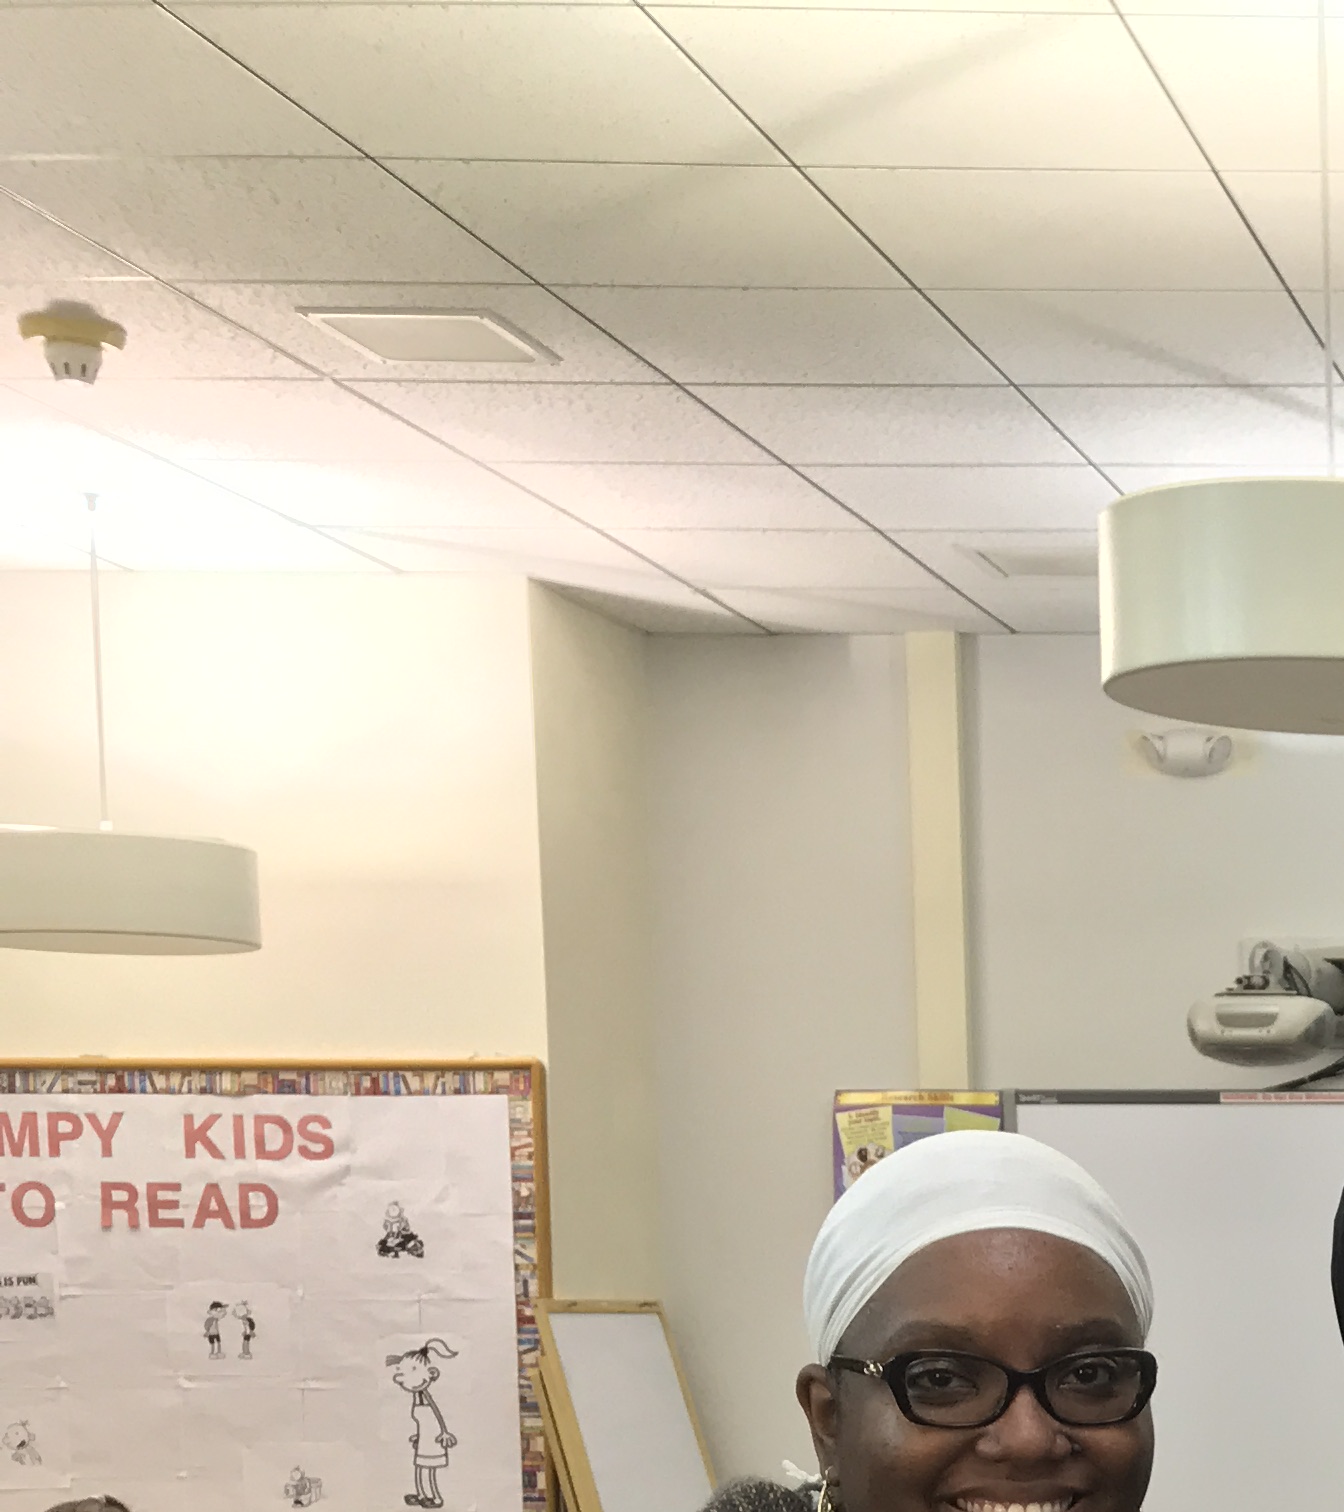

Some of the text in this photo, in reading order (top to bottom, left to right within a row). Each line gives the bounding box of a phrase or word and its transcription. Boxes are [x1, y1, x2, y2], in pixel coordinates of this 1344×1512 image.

[183, 1113, 336, 1161] KIDS
[0, 1181, 280, 1229] O READ
